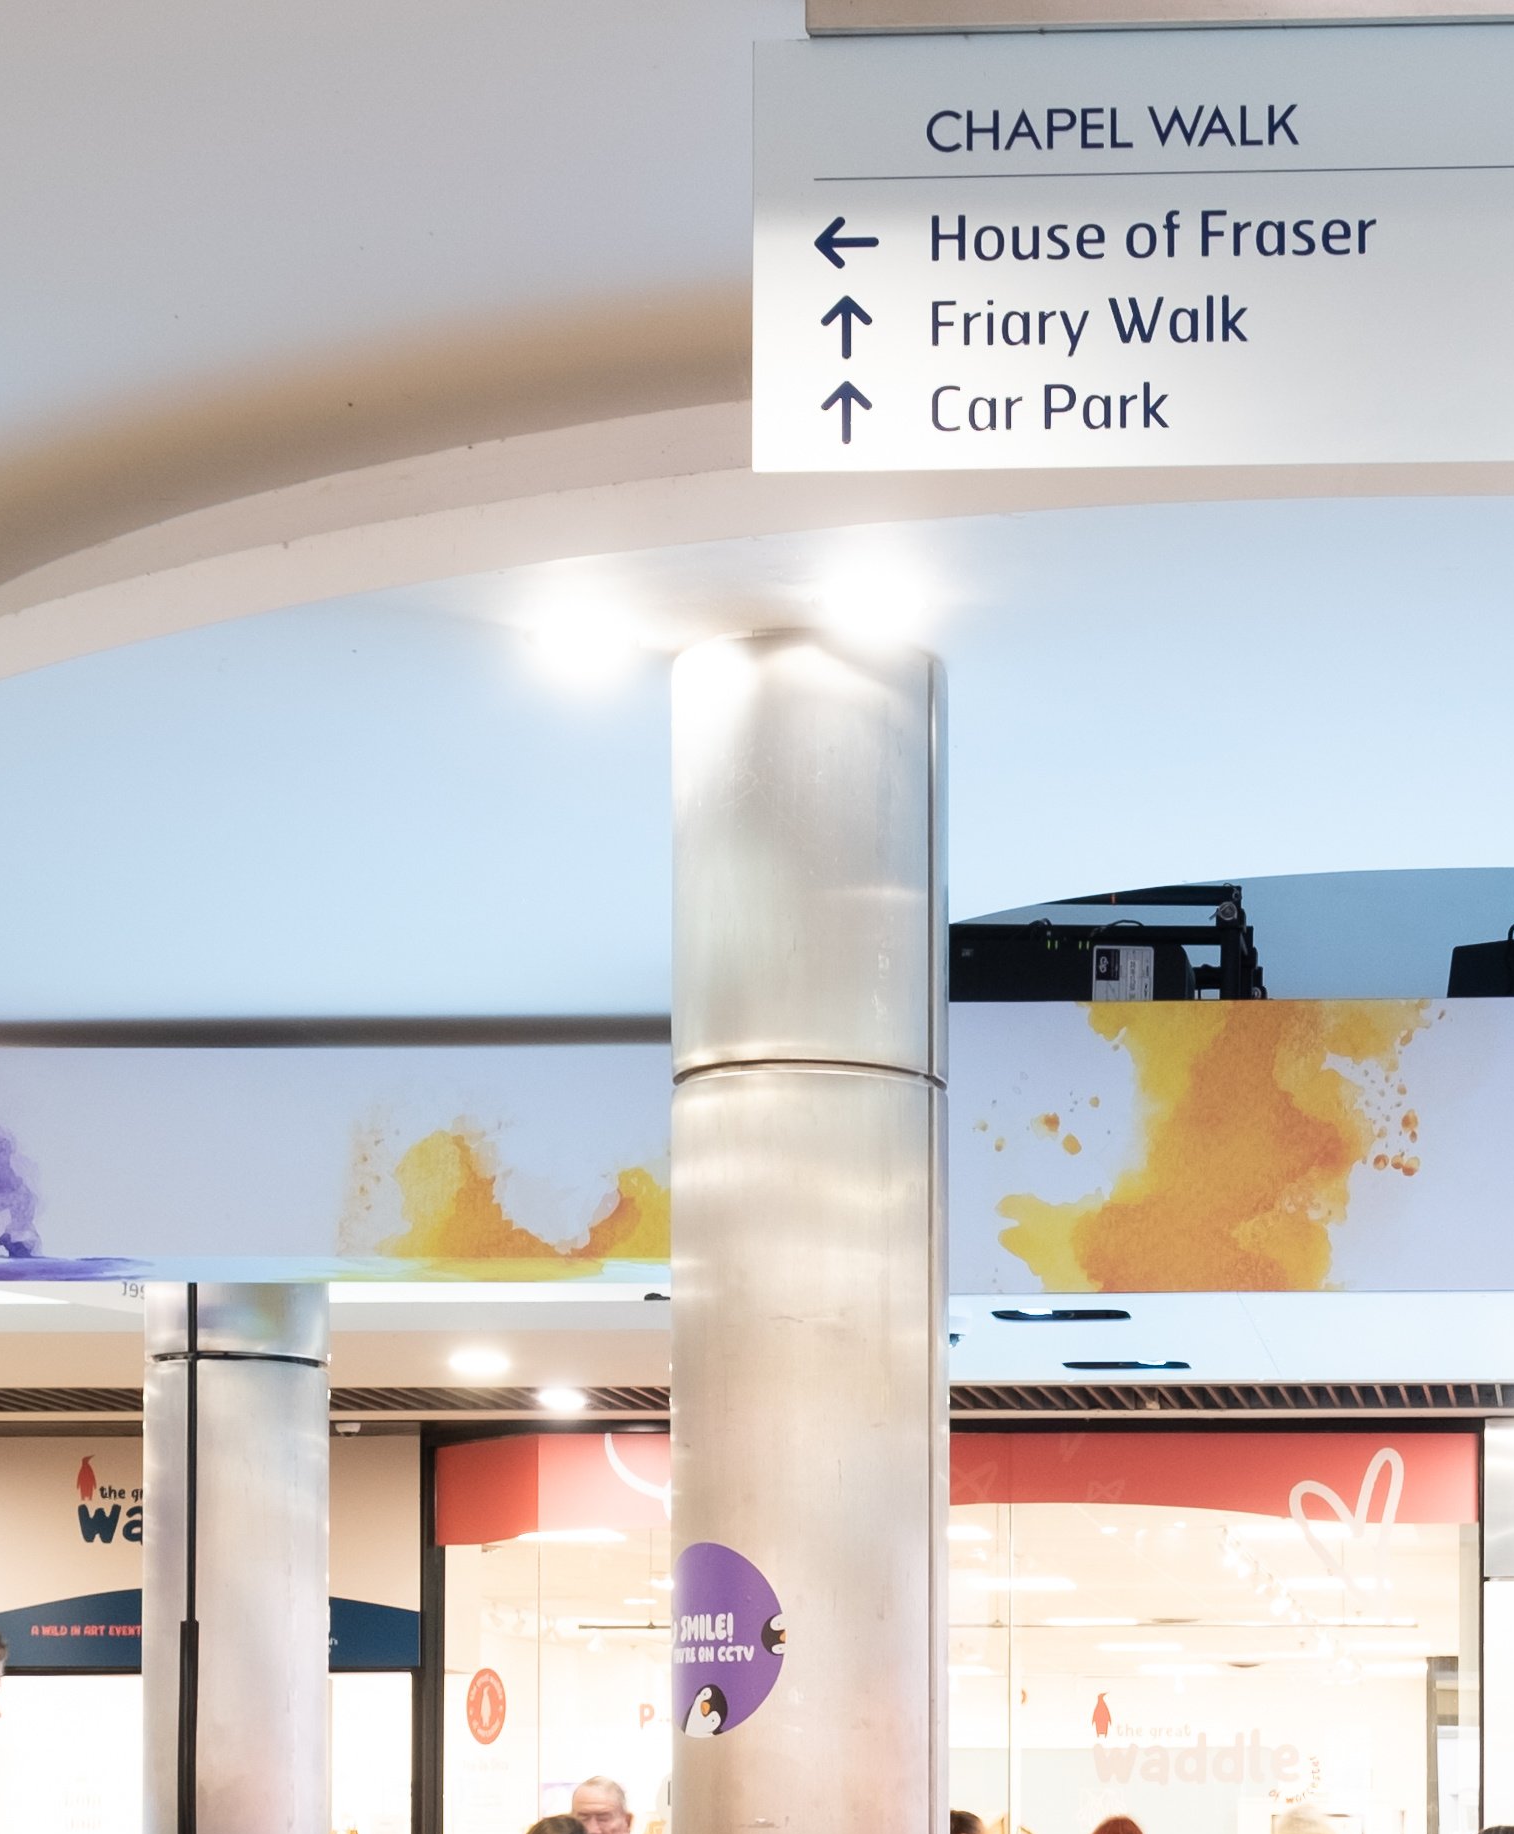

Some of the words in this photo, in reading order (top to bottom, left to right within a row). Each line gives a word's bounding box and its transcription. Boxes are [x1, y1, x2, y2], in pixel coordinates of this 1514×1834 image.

[927, 108, 1133, 152] CHAPEL
[1148, 105, 1298, 146] WALK
[932, 215, 1105, 261] House
[1126, 210, 1180, 258] of
[1202, 210, 1376, 256] Fraser
[932, 300, 1089, 357] Friary
[1109, 295, 1247, 343] Walk
[932, 386, 1022, 431] Car
[1045, 382, 1169, 429] Park
[99, 1486, 125, 1499] the
[31, 1626, 39, 1636] A
[42, 1625, 67, 1636] WILD
[71, 1625, 80, 1636] IN
[84, 1625, 105, 1636] ART
[680, 1612, 734, 1643] SMILE!
[697, 1646, 715, 1663] ON
[717, 1645, 755, 1662] CCTV
[1093, 1729, 1300, 1785] waddle
